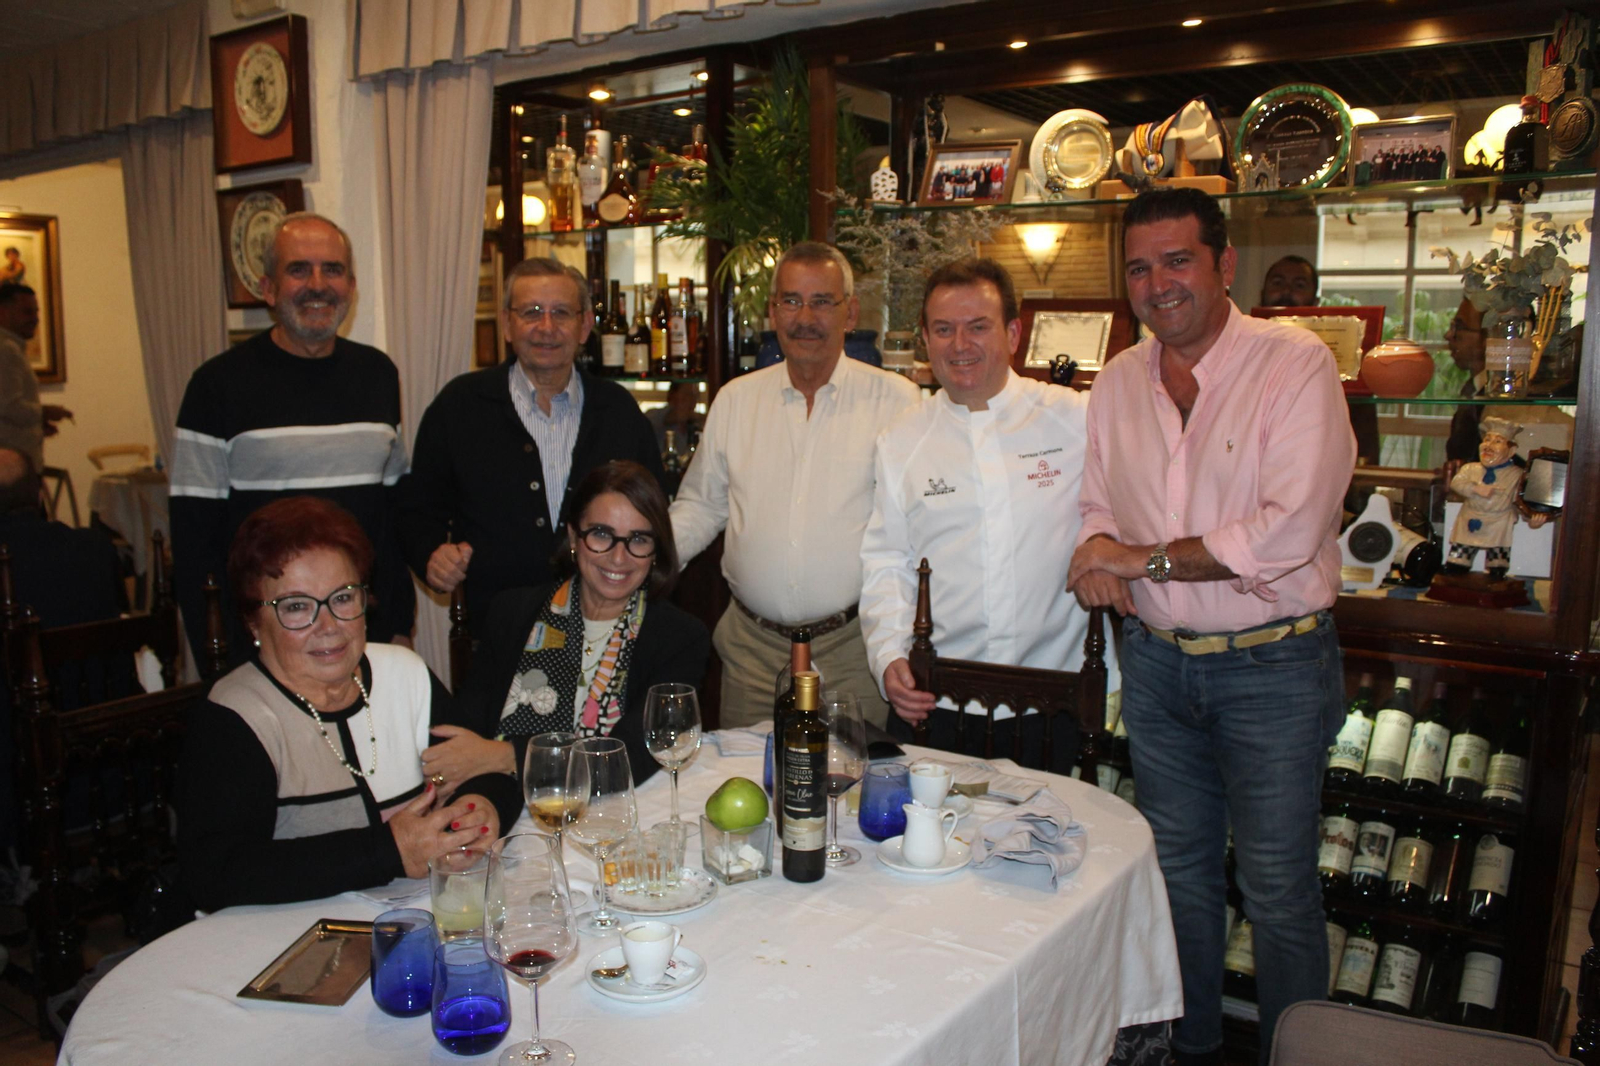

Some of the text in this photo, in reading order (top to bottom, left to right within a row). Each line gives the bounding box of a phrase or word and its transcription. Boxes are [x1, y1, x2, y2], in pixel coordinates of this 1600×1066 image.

[1027, 469, 1061, 481] MICHELIN
[1037, 480, 1055, 488] 2025
[924, 488, 956, 497] MICHELIN
